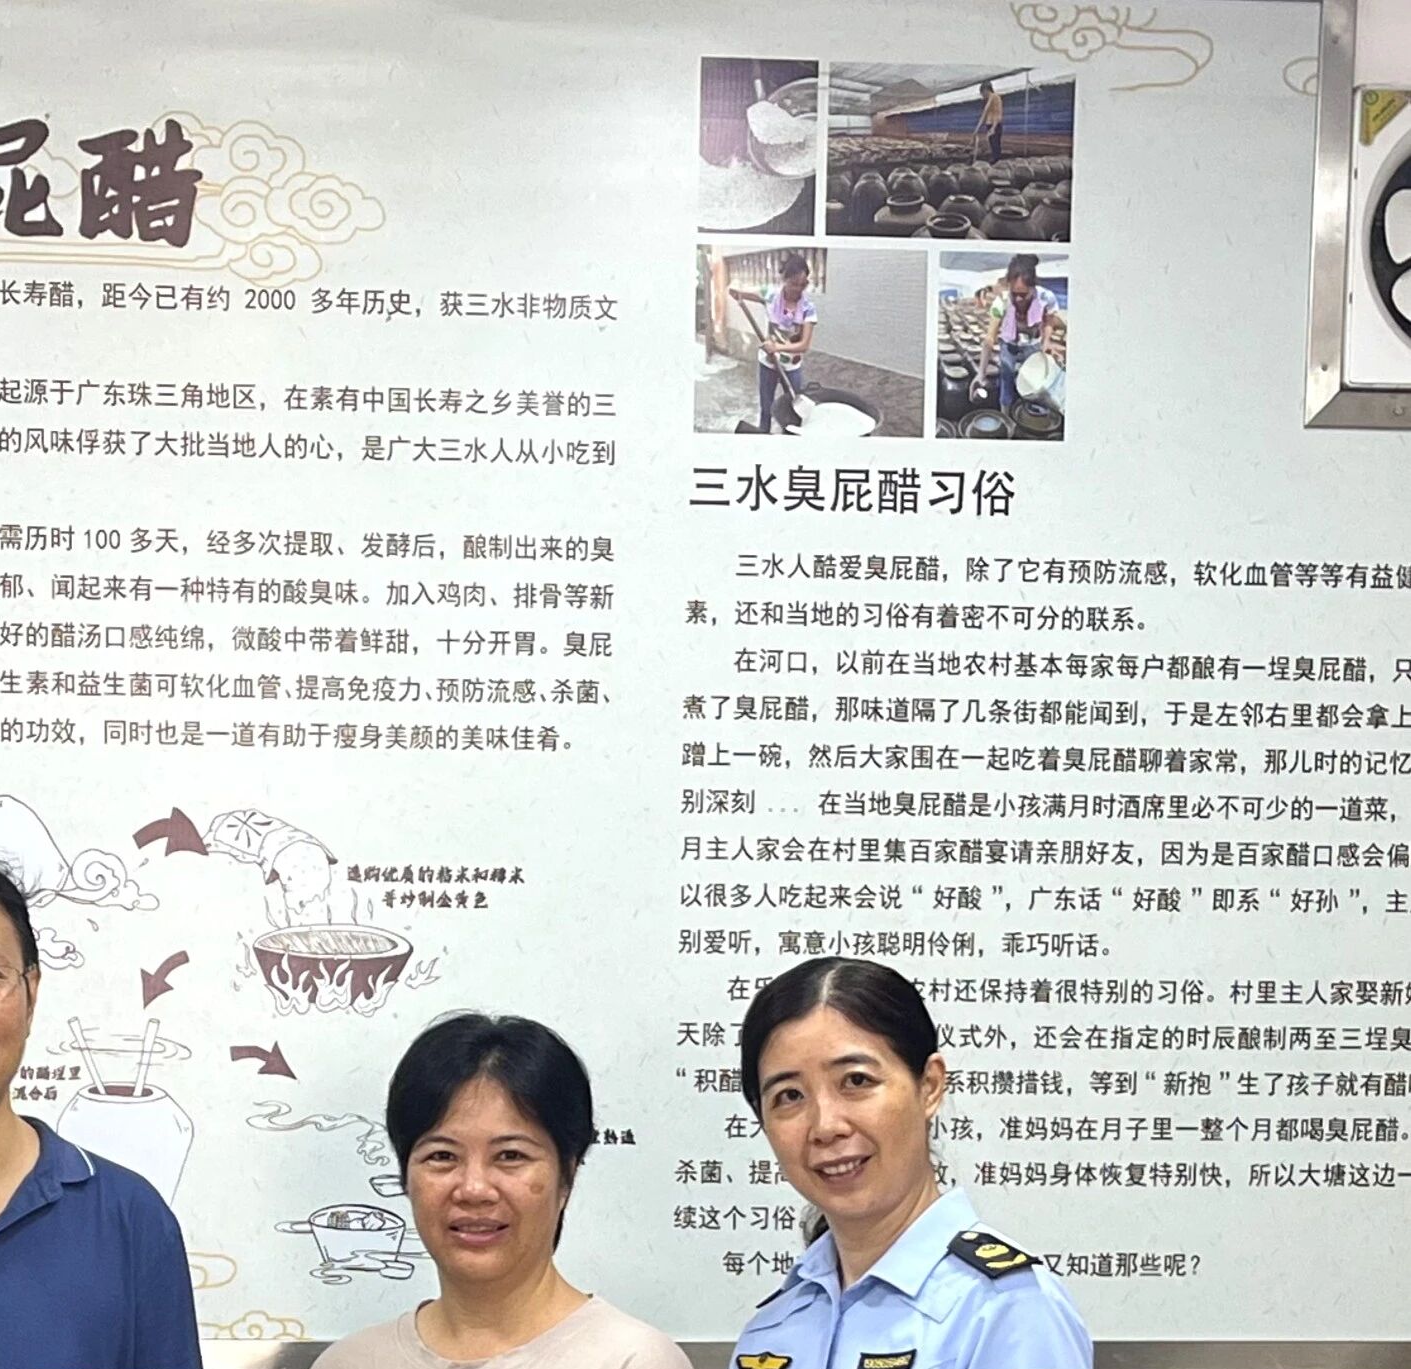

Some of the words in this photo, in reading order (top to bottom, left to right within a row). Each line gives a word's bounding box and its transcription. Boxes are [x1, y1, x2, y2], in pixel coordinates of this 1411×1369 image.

[689, 464, 1015, 516] 三水臭屁醋习俗
